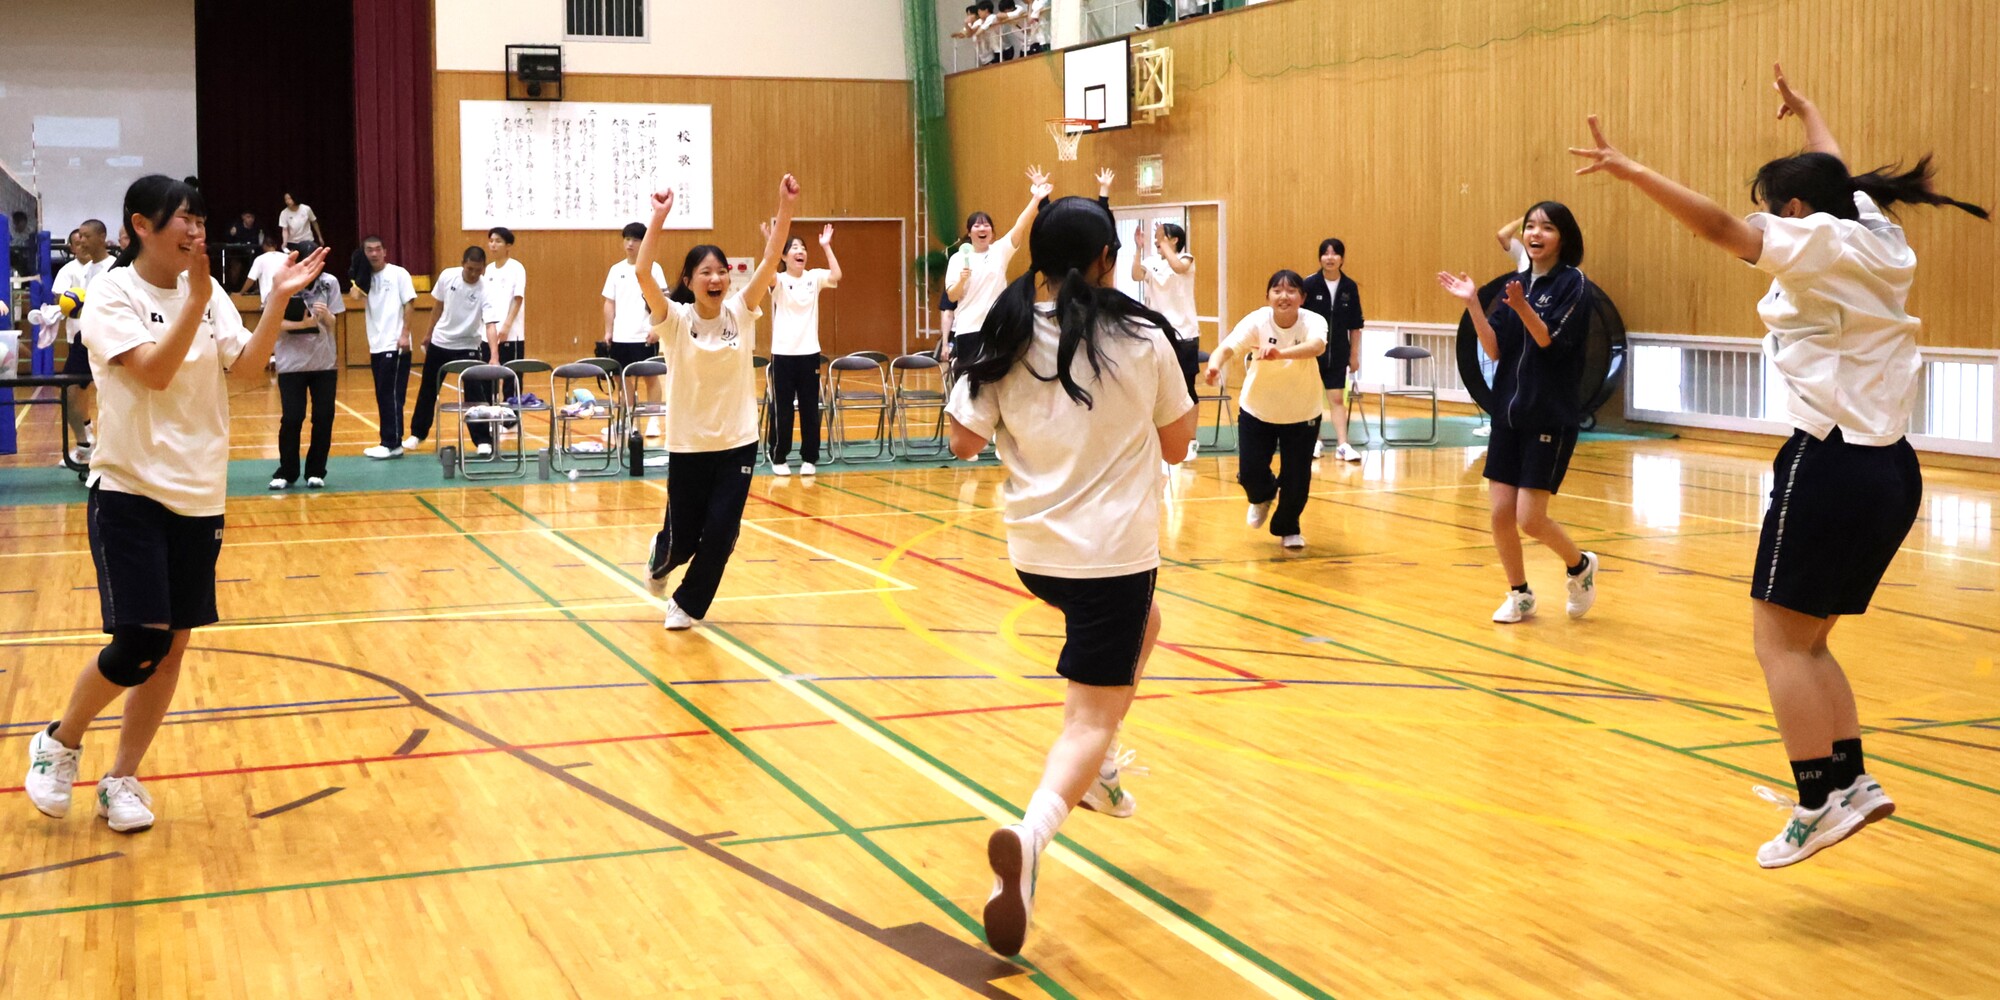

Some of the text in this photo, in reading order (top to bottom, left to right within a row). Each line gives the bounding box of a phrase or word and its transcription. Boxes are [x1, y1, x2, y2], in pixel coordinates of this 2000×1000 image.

[677, 130, 691, 167] 校歌
[1831, 752, 1847, 763] AP
[1799, 770, 1823, 781] GAP
